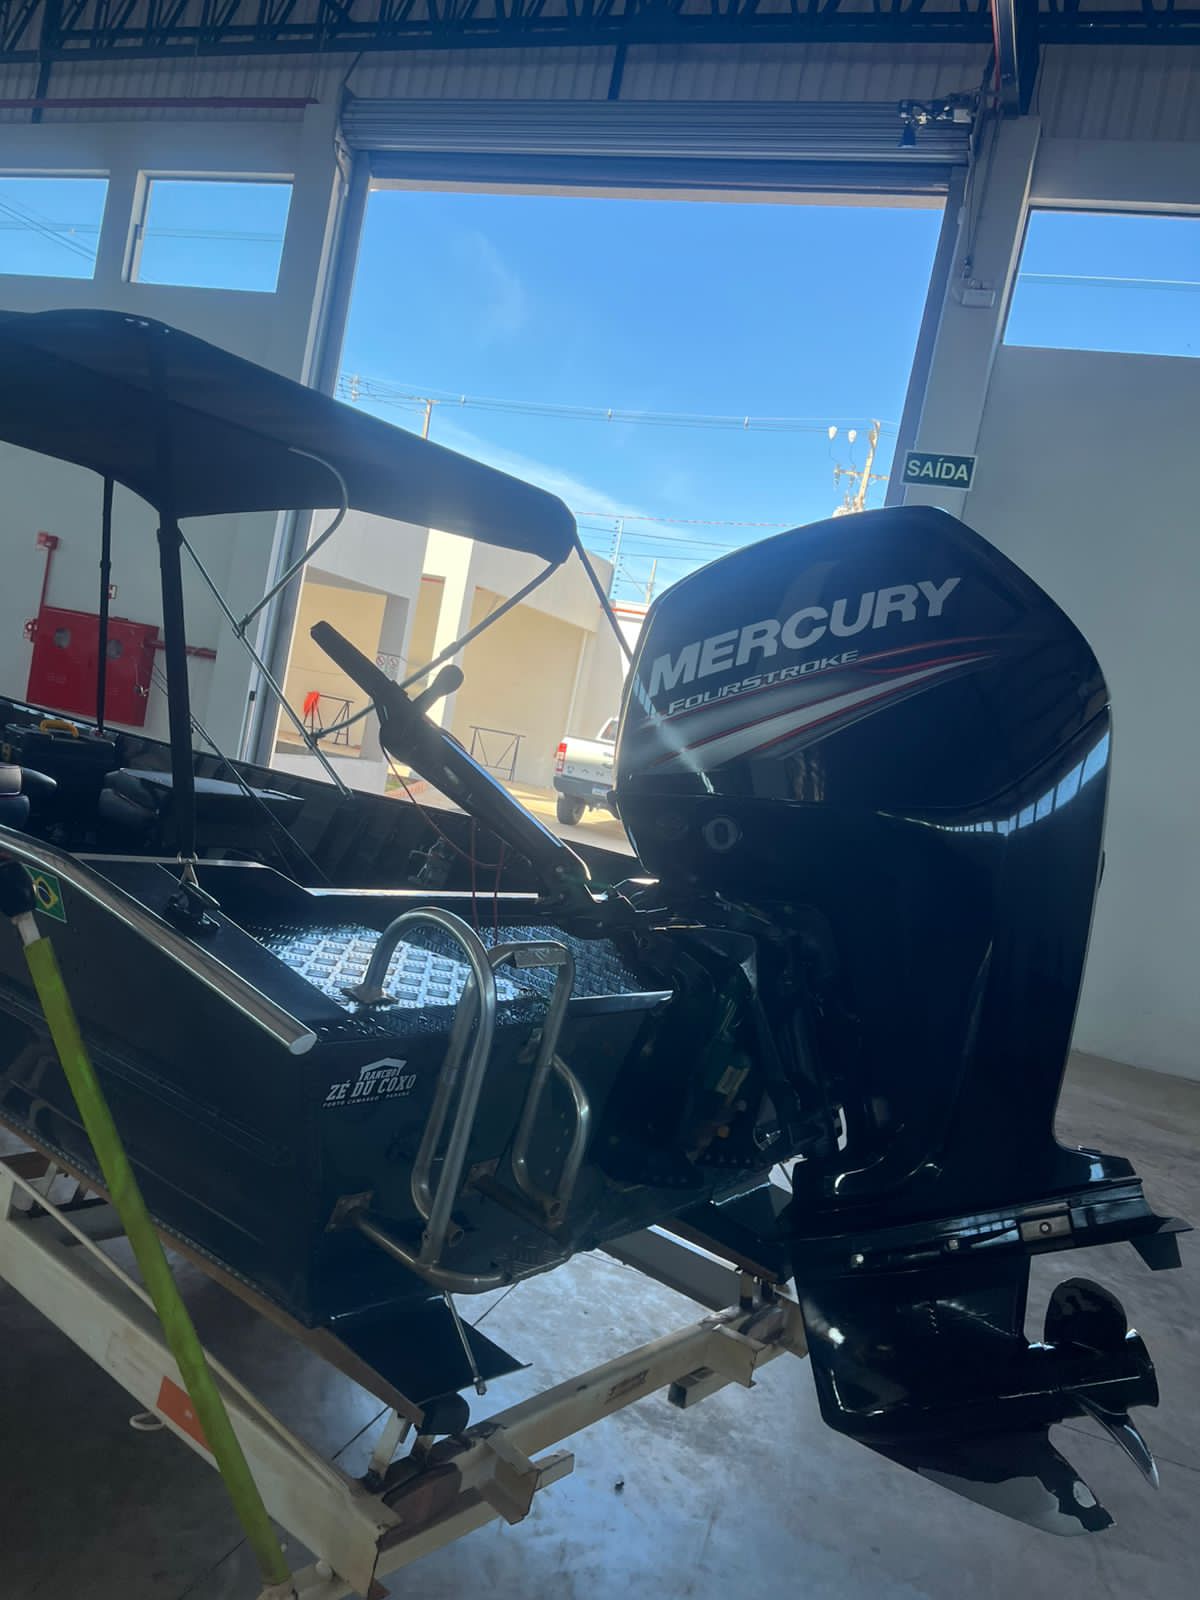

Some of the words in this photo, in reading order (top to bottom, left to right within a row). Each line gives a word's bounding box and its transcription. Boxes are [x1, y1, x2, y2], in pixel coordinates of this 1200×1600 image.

[907, 457, 968, 481] SAÍDA
[649, 577, 961, 698] MERCURY
[667, 649, 860, 715] FOURSTROKE
[325, 1080, 351, 1101] ZÉ
[350, 1081, 376, 1098] DU
[377, 1075, 417, 1094] COXO
